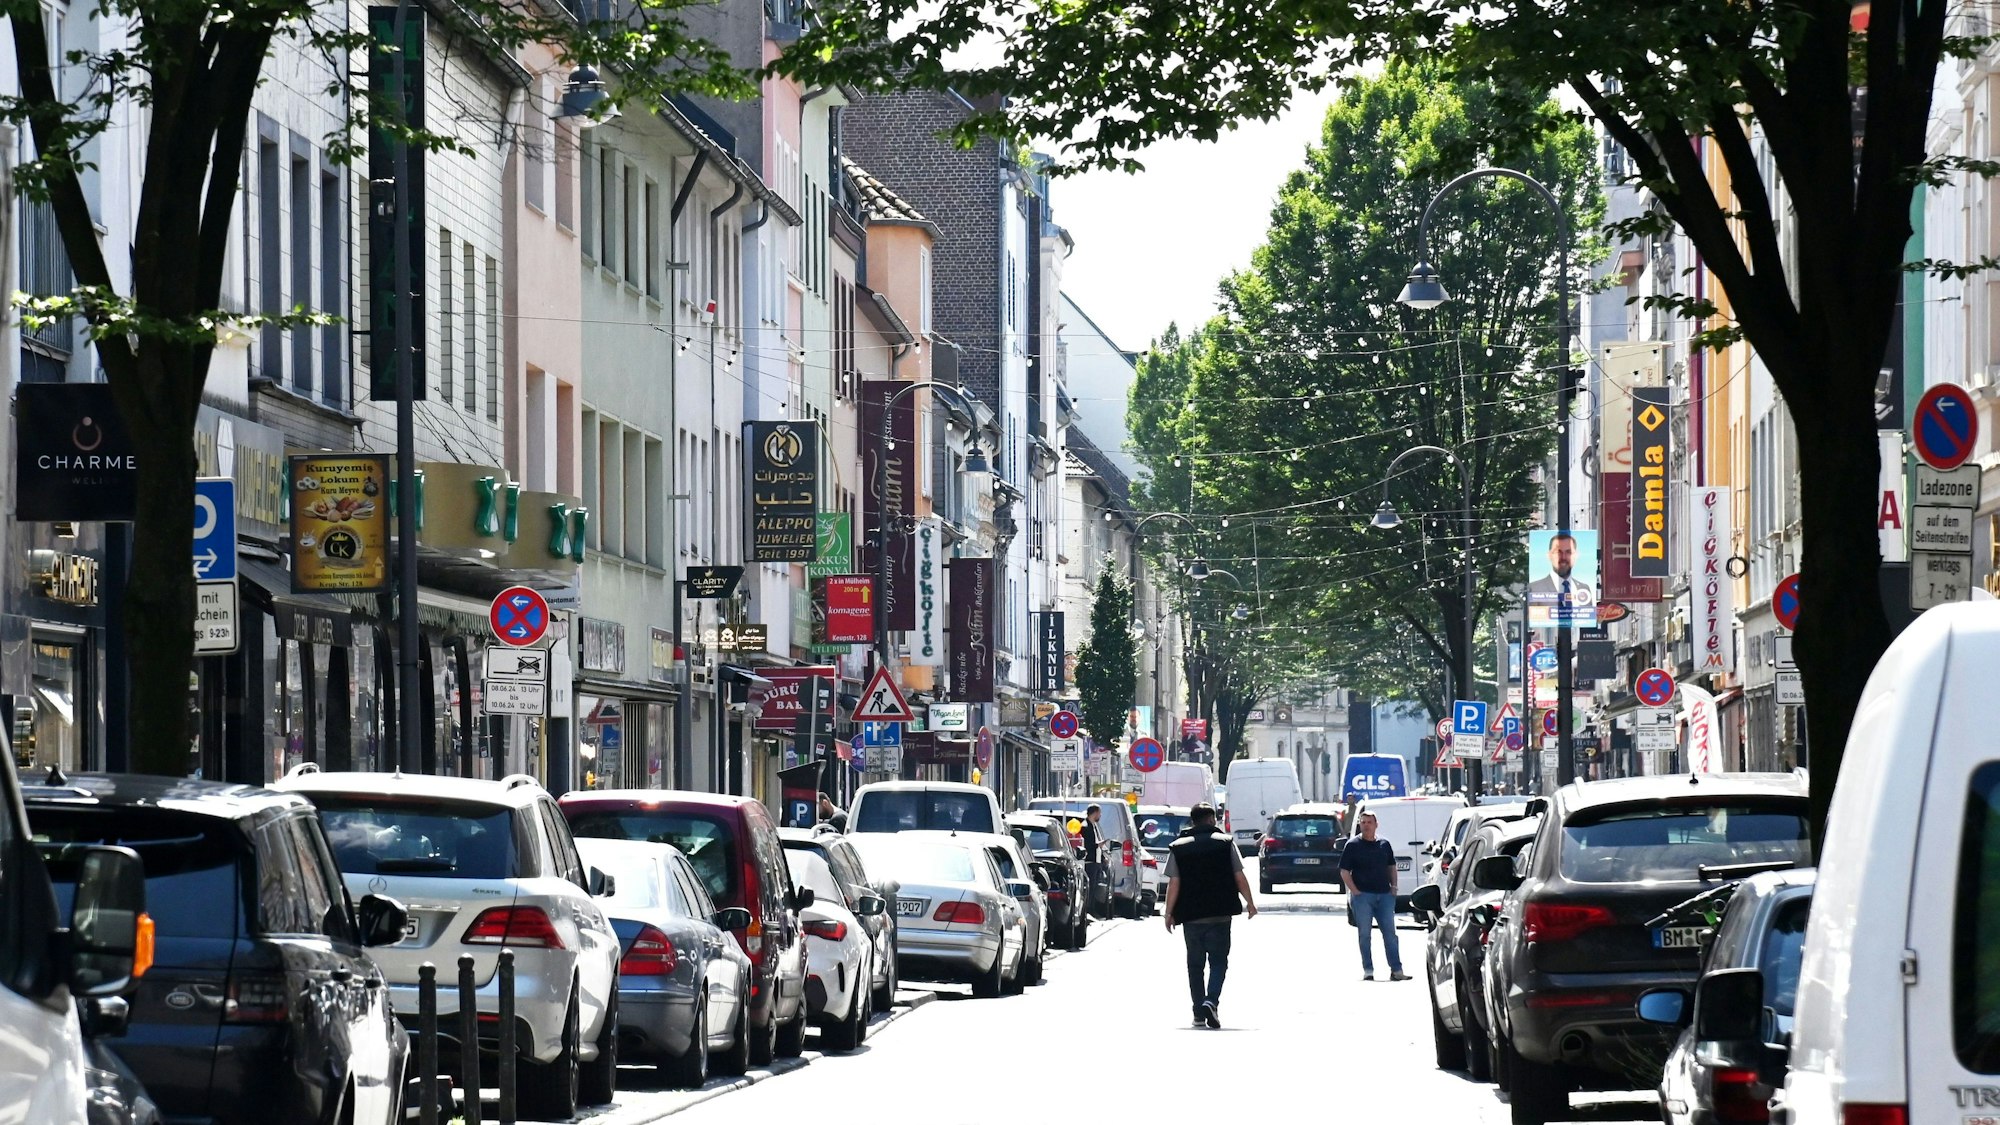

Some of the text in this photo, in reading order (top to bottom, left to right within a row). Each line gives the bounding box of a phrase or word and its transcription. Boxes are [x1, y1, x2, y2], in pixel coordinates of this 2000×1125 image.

[38, 455, 137, 469] CHARME
[306, 464, 374, 474] Kuruyemiş
[320, 476, 359, 484] Lokum
[755, 470, 815, 484] مجوهرات
[320, 487, 360, 496] Kuru Meyve
[1920, 478, 1973, 496] Ladezone
[1638, 444, 1664, 560] Damla
[756, 518, 813, 530] ALEPPO
[1926, 514, 1960, 527] auf dem
[1915, 530, 1969, 545] Seitenstreifen
[330, 541, 350, 557] CK
[757, 549, 809, 559] Seit 1991
[816, 556, 848, 564] KKUS
[1926, 557, 1961, 575] werktags
[810, 566, 849, 576] KONYA
[1631, 585, 1653, 593] 1970
[1929, 583, 1934, 599] 7
[201, 593, 219, 604] mit
[828, 606, 870, 615] komagene
[209, 626, 230, 639] 9-23h
[959, 652, 967, 695] Backsube
[1461, 705, 1478, 730] P
[796, 803, 807, 821] P
[1663, 930, 1683, 946] BM
